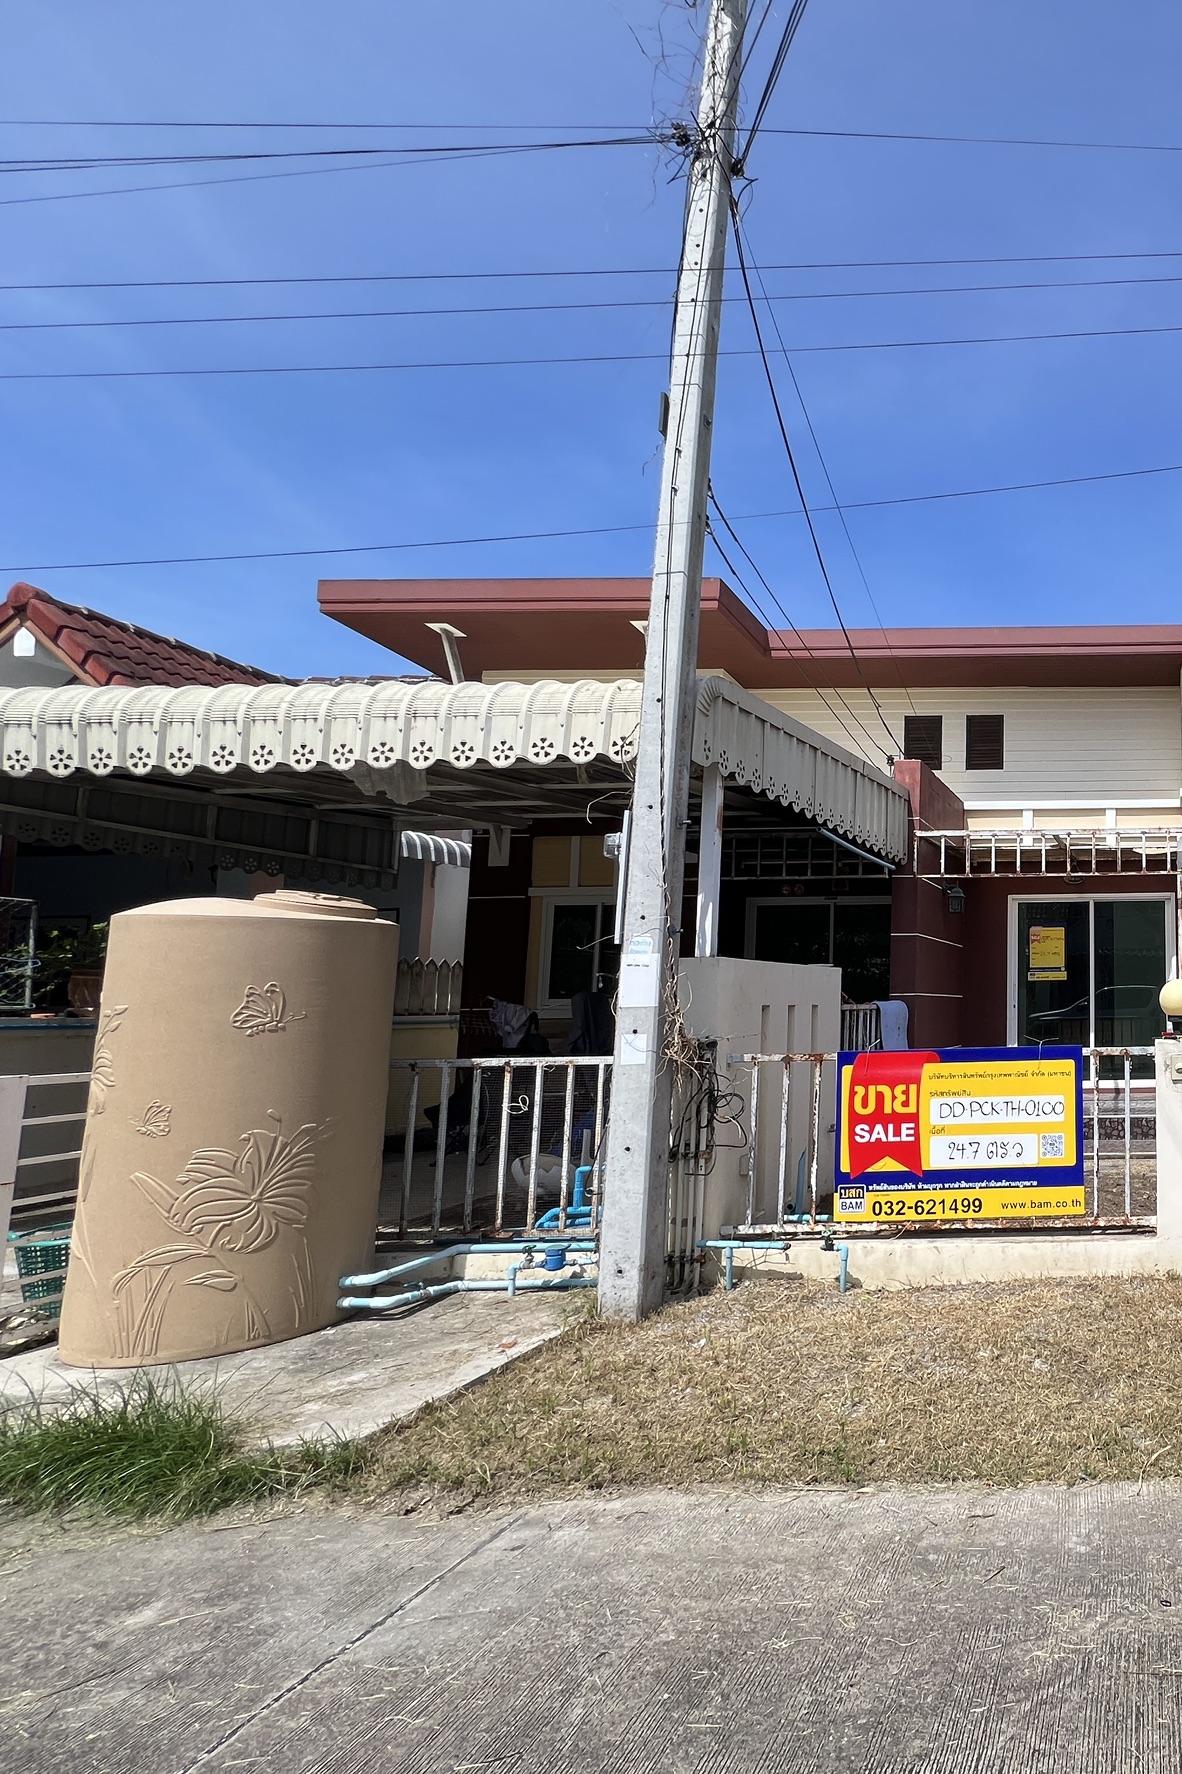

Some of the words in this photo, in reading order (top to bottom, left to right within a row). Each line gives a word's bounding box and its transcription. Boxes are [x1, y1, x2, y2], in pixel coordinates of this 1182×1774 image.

[853, 1083, 917, 1115] ขาย
[854, 1122, 915, 1144] SALE
[948, 1141, 981, 1160] 24.7
[840, 1187, 864, 1199] บสก
[840, 1201, 863, 1212] BAM
[871, 1197, 983, 1217] 032-621499
[1000, 1198, 1082, 1210] www.bam.co.th
